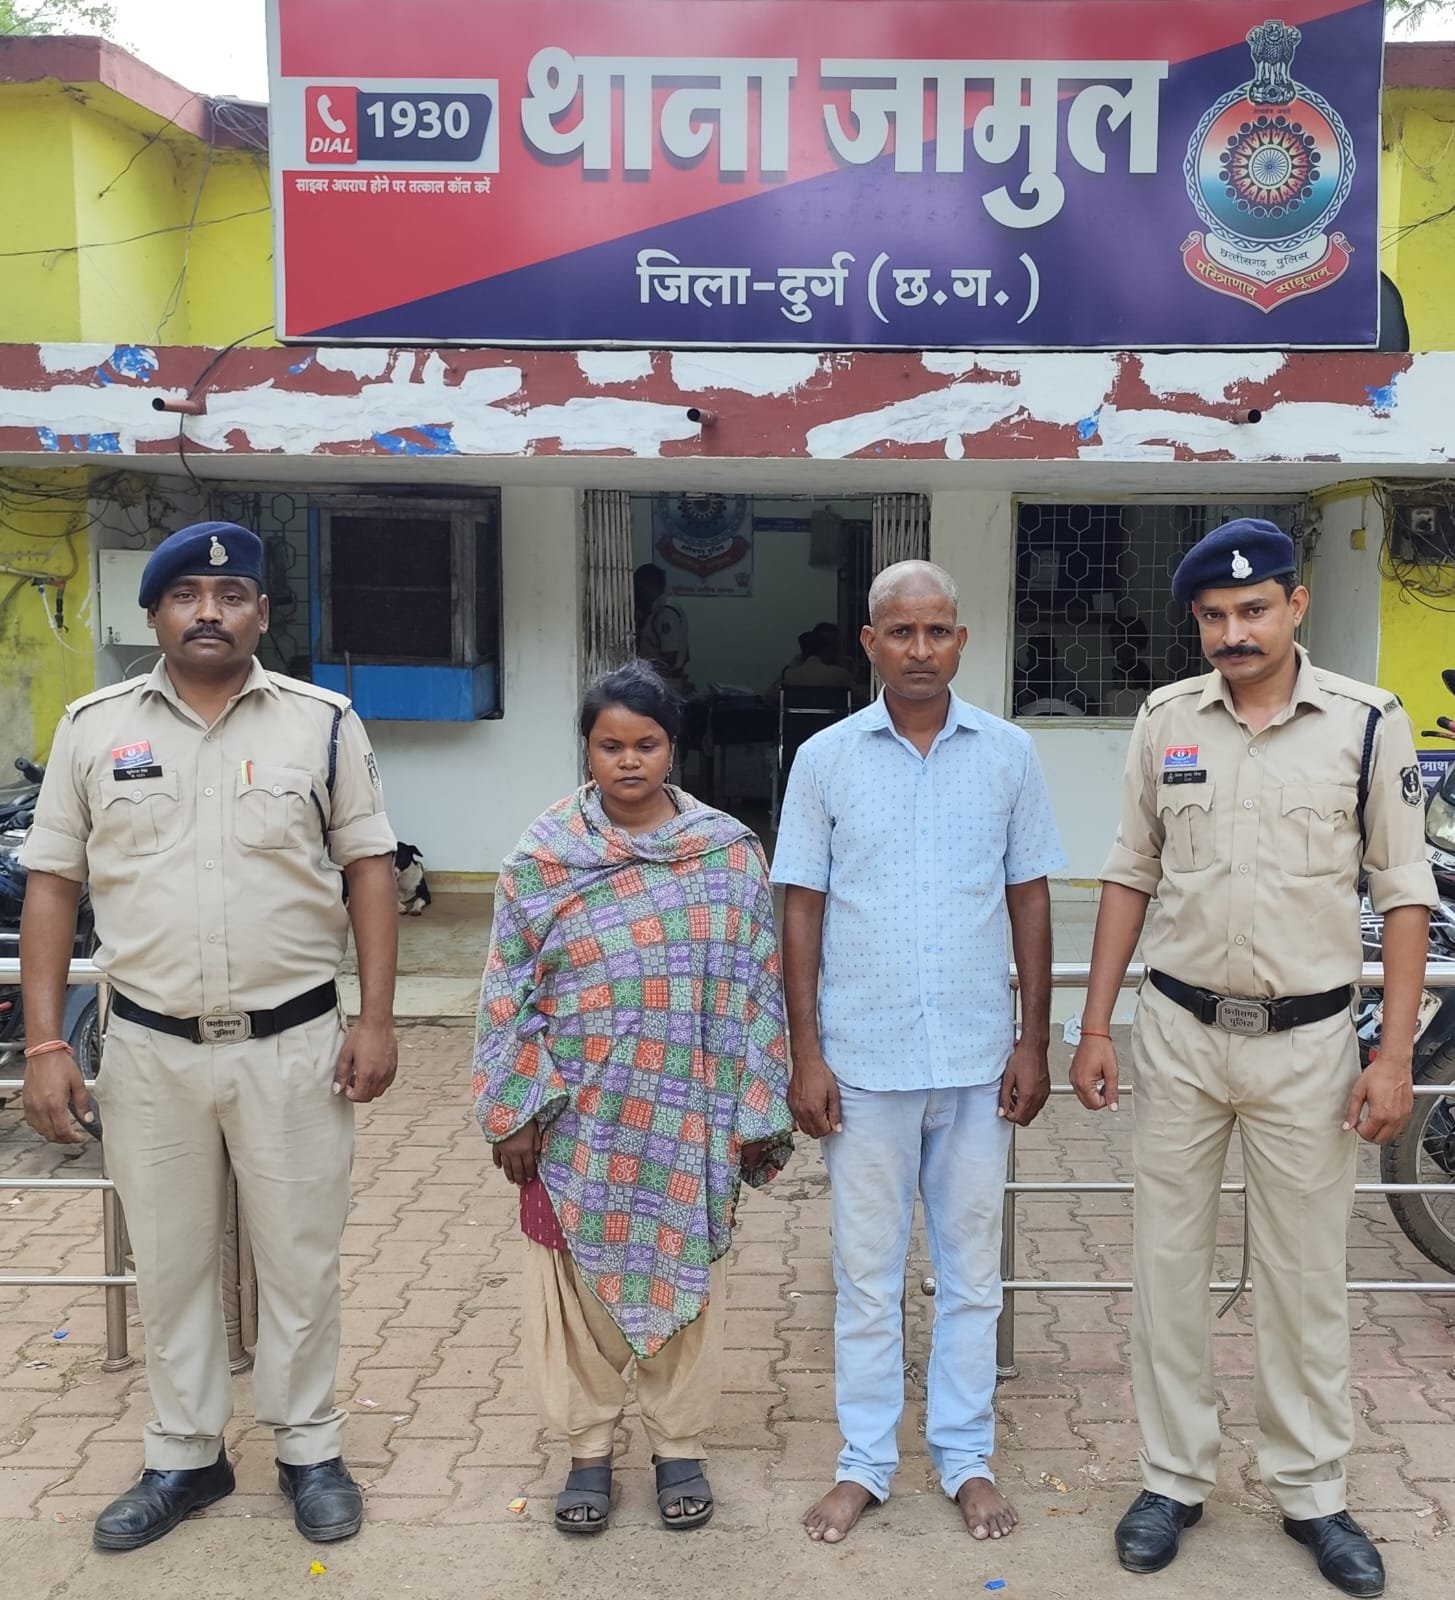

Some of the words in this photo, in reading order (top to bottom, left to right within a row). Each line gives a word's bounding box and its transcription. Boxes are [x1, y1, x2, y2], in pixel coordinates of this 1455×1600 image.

[366, 100, 470, 139] 1930
[309, 137, 353, 153] DIAL
[521, 46, 798, 172] थाना
[820, 58, 1169, 228] जामुल
[370, 176, 389, 194] होने
[392, 180, 406, 193] पर
[408, 180, 445, 194] तत्काल
[448, 177, 471, 194] कॉल
[474, 176, 491, 194] करें
[1276, 251, 1310, 270] पुलिस
[635, 248, 856, 323] जिला-दुर्ग
